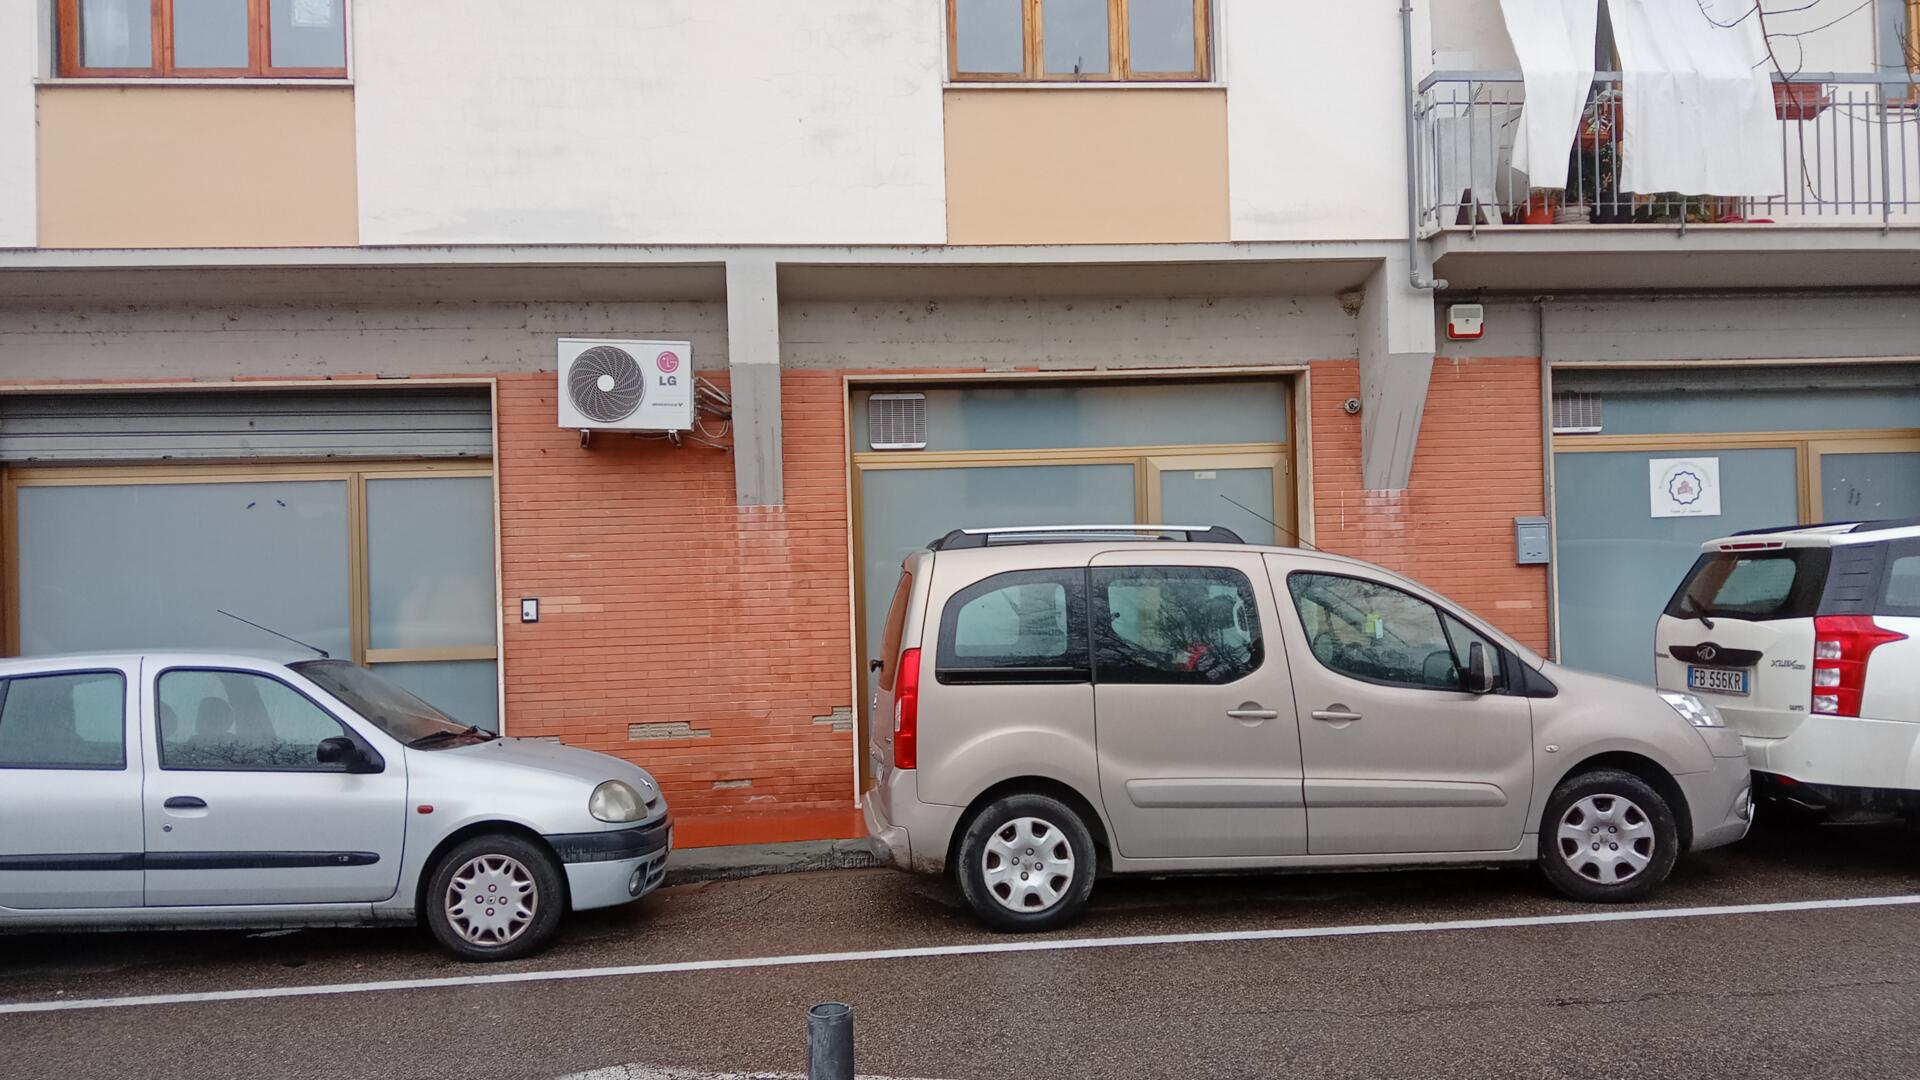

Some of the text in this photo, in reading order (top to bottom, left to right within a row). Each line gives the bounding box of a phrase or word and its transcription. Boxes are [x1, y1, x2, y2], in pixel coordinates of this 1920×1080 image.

[659, 376, 677, 386] LG
[1694, 669, 1742, 690] FB 556KR
